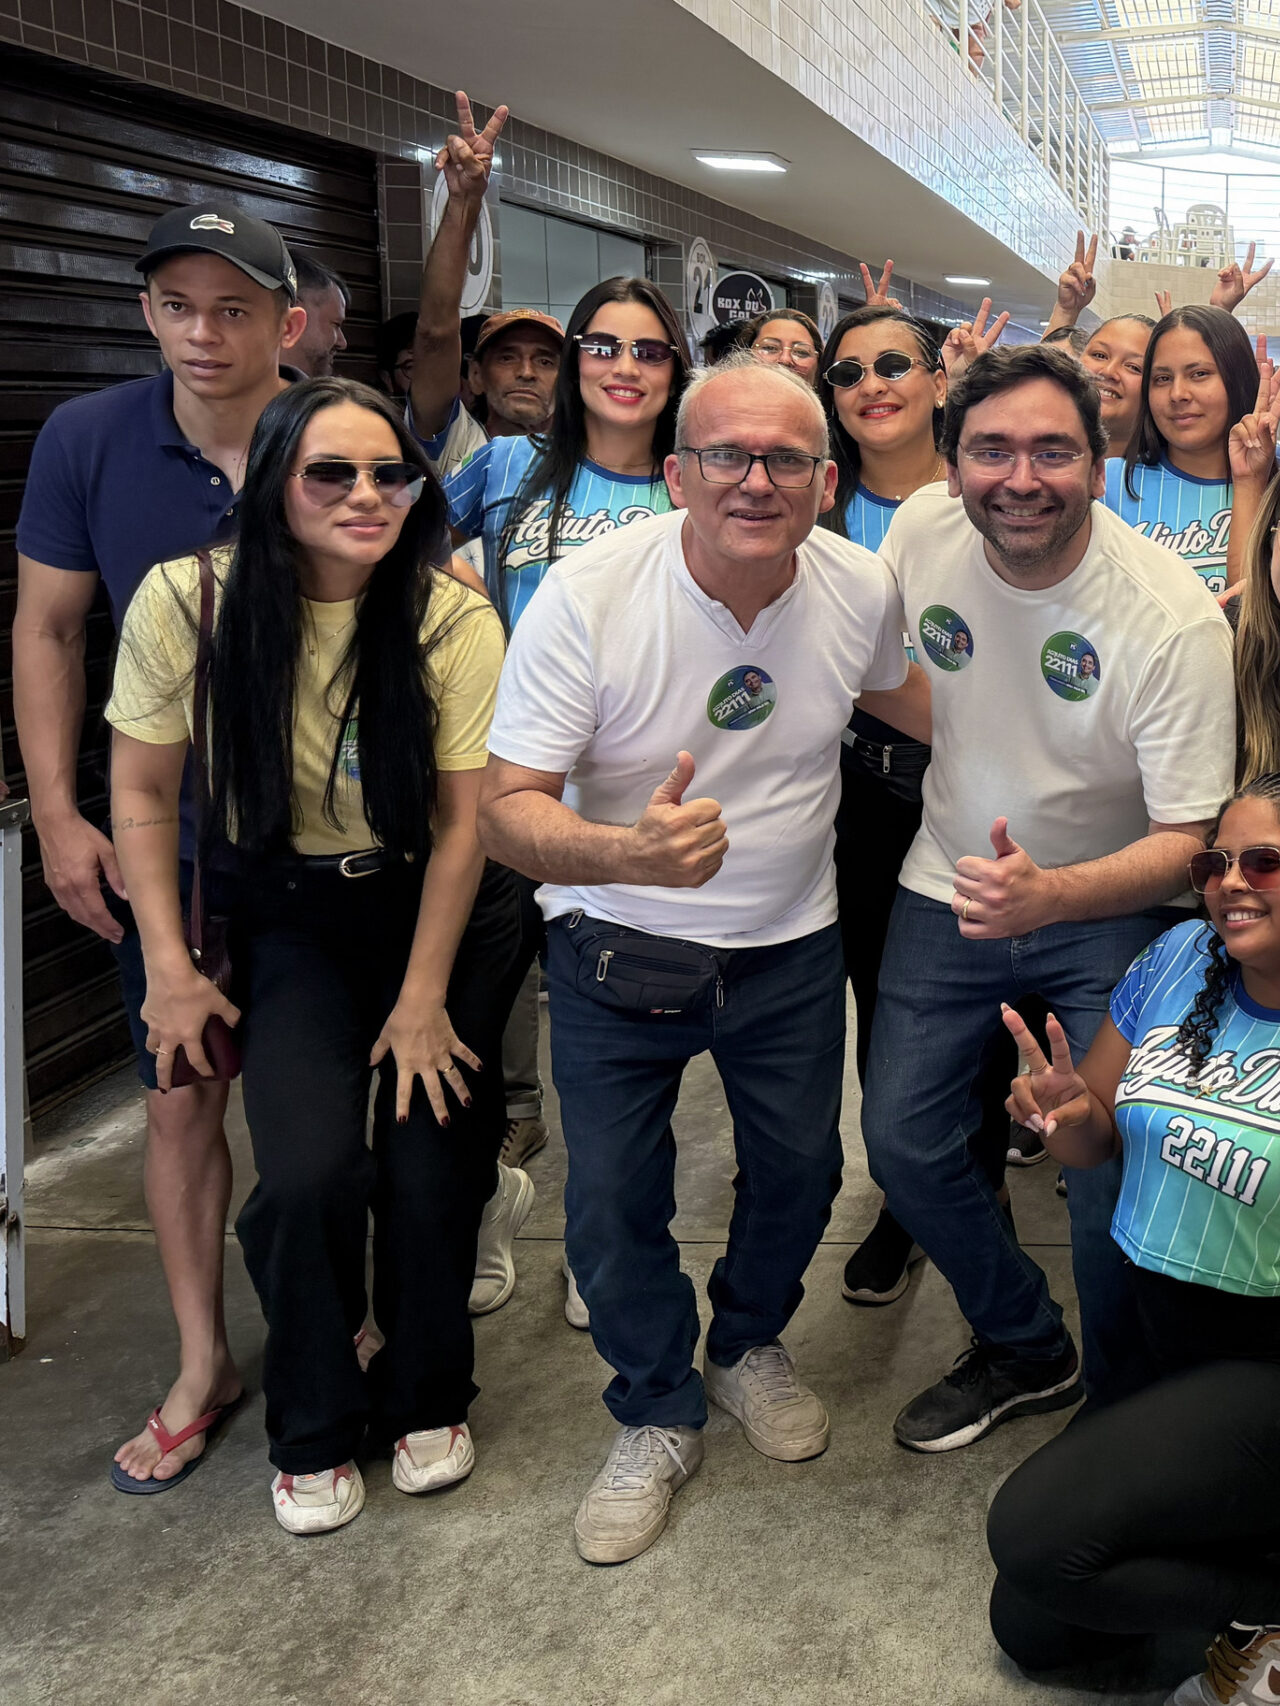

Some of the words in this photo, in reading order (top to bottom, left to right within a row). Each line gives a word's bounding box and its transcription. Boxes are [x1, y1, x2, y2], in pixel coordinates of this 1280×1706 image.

[717, 297, 741, 310] BOX
[922, 622, 951, 650] 22111
[1044, 655, 1078, 678] 22111
[714, 691, 751, 722] 22111
[1160, 1114, 1272, 1208] 22111
